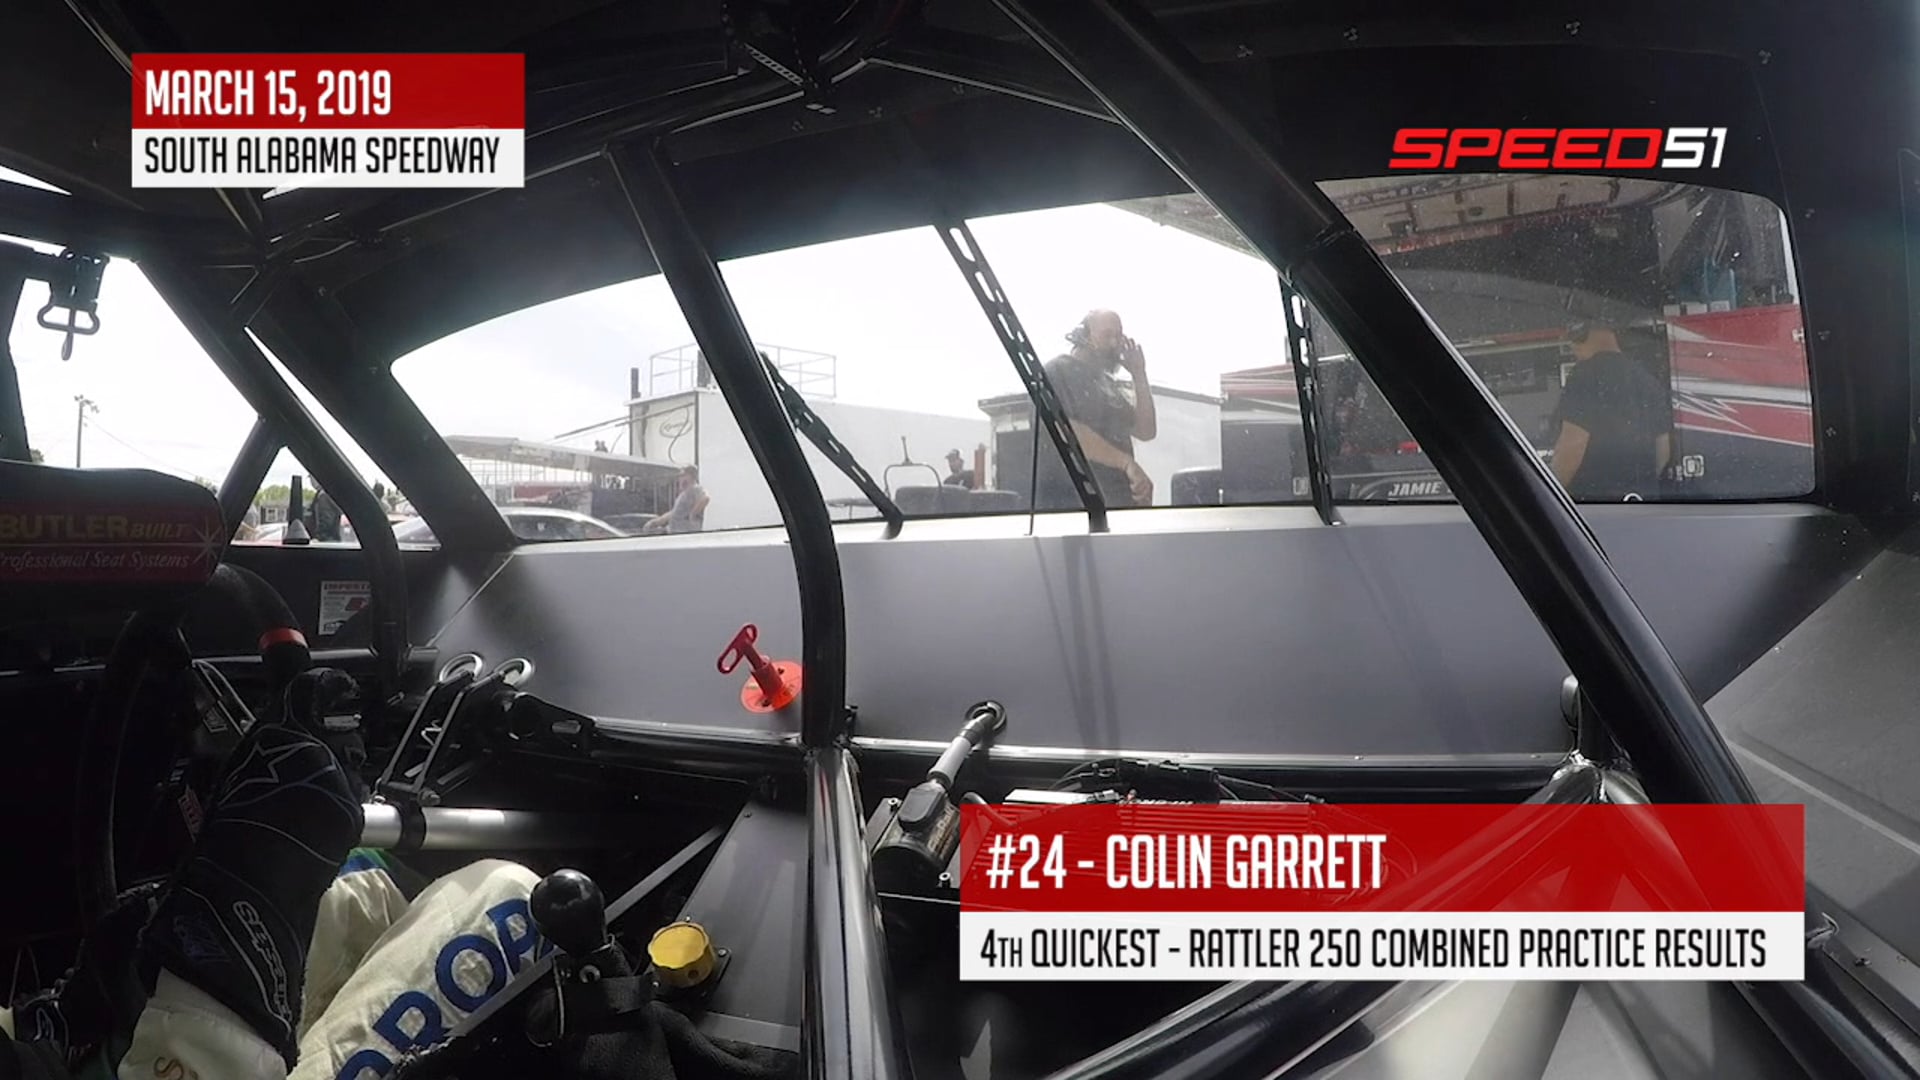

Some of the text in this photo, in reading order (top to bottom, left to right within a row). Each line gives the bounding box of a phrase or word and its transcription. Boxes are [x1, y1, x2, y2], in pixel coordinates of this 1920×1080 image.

[1388, 482, 1442, 496] JAMIE
[0, 551, 189, 571] rofessional Seat Systems
